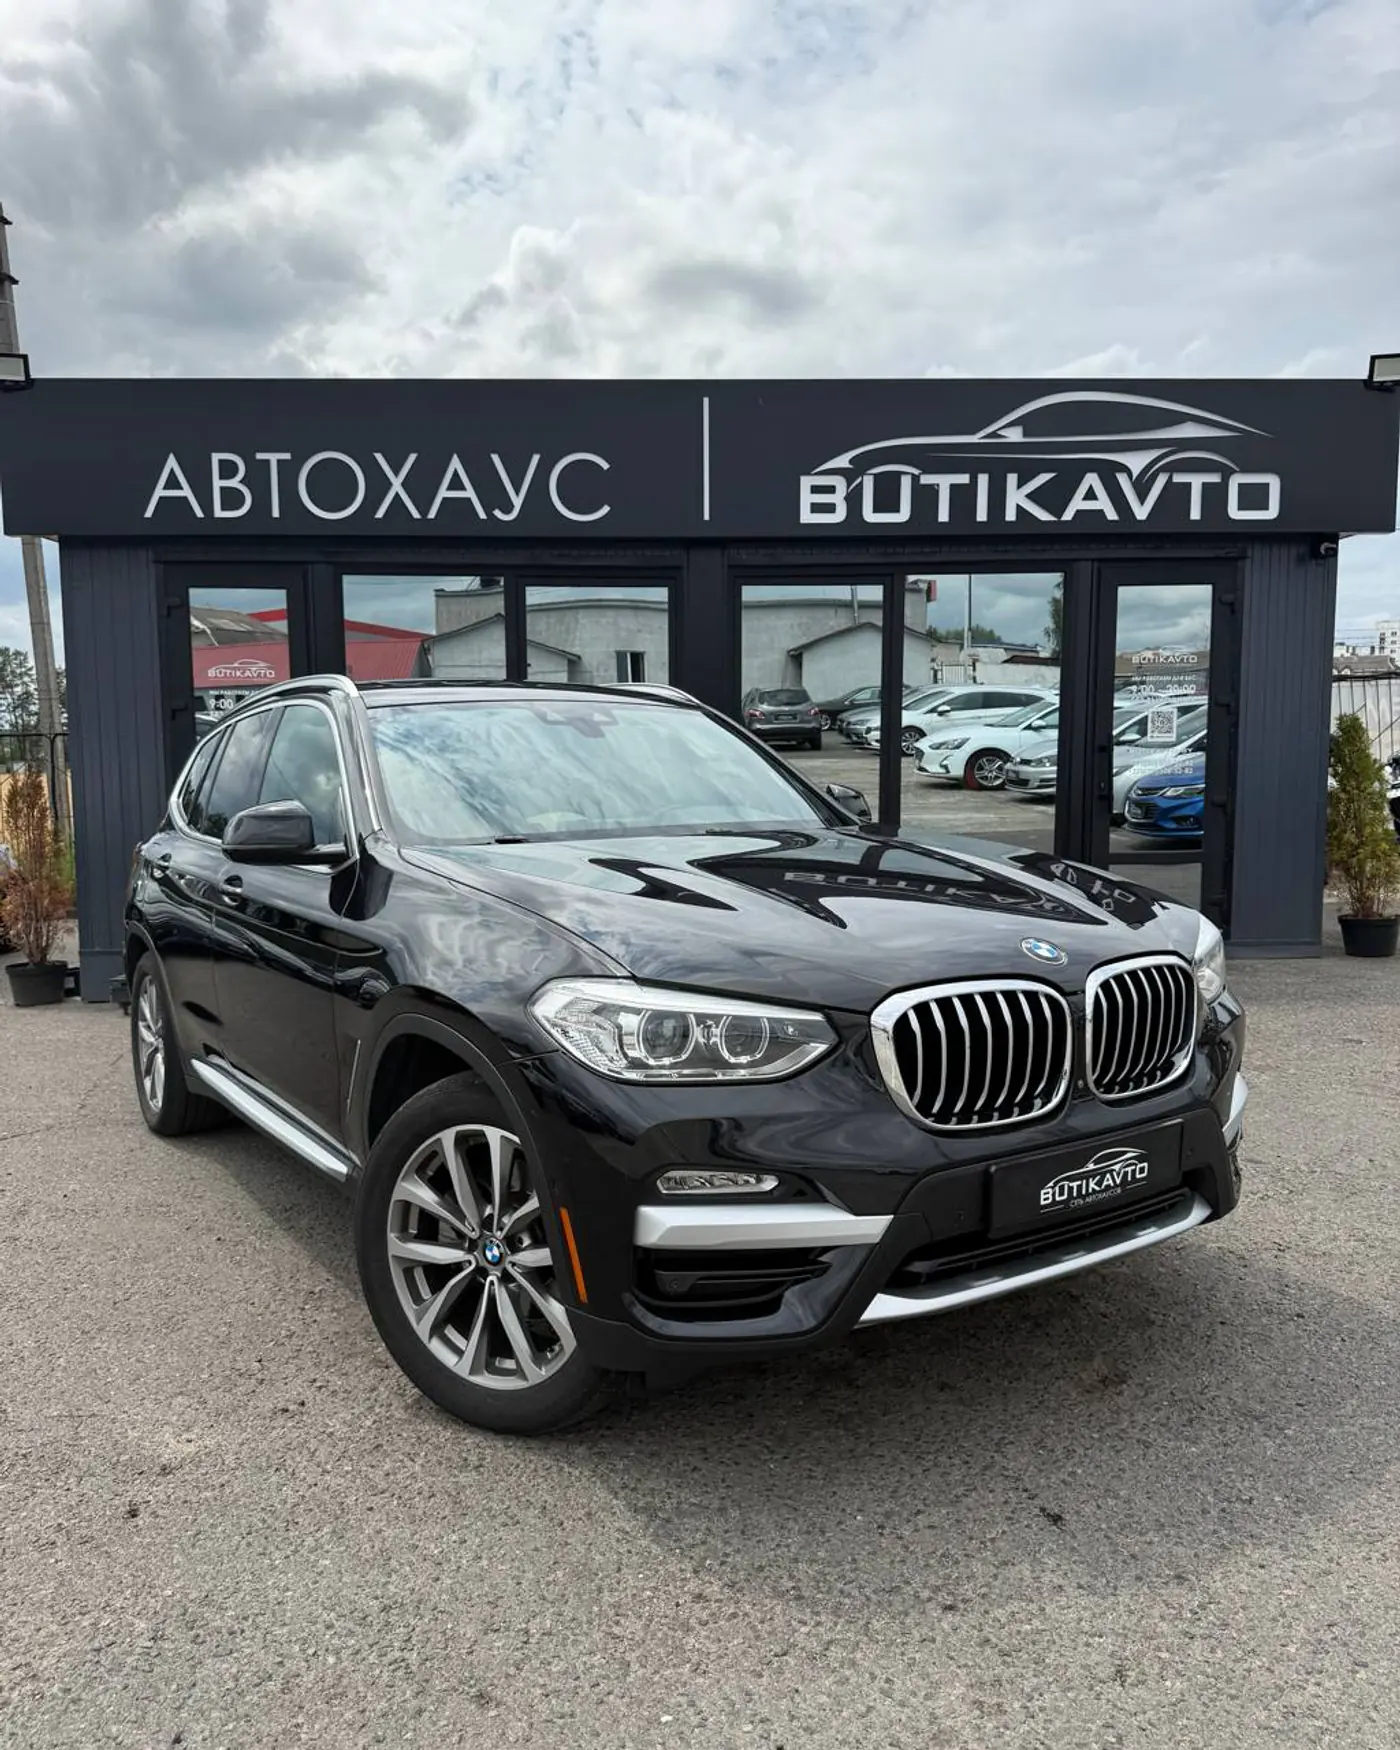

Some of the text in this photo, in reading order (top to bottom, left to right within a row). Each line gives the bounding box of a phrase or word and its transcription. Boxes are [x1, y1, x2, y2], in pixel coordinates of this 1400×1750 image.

[144, 450, 612, 523] АВТОХАУС
[799, 470, 1281, 525] BUTIKAVTO
[1131, 655, 1198, 663] BUTIKAVTO
[207, 669, 275, 678] BUTIKAVTO
[209, 698, 234, 710] 9:00
[1040, 1162, 1149, 1205] BUTIKAVTO
